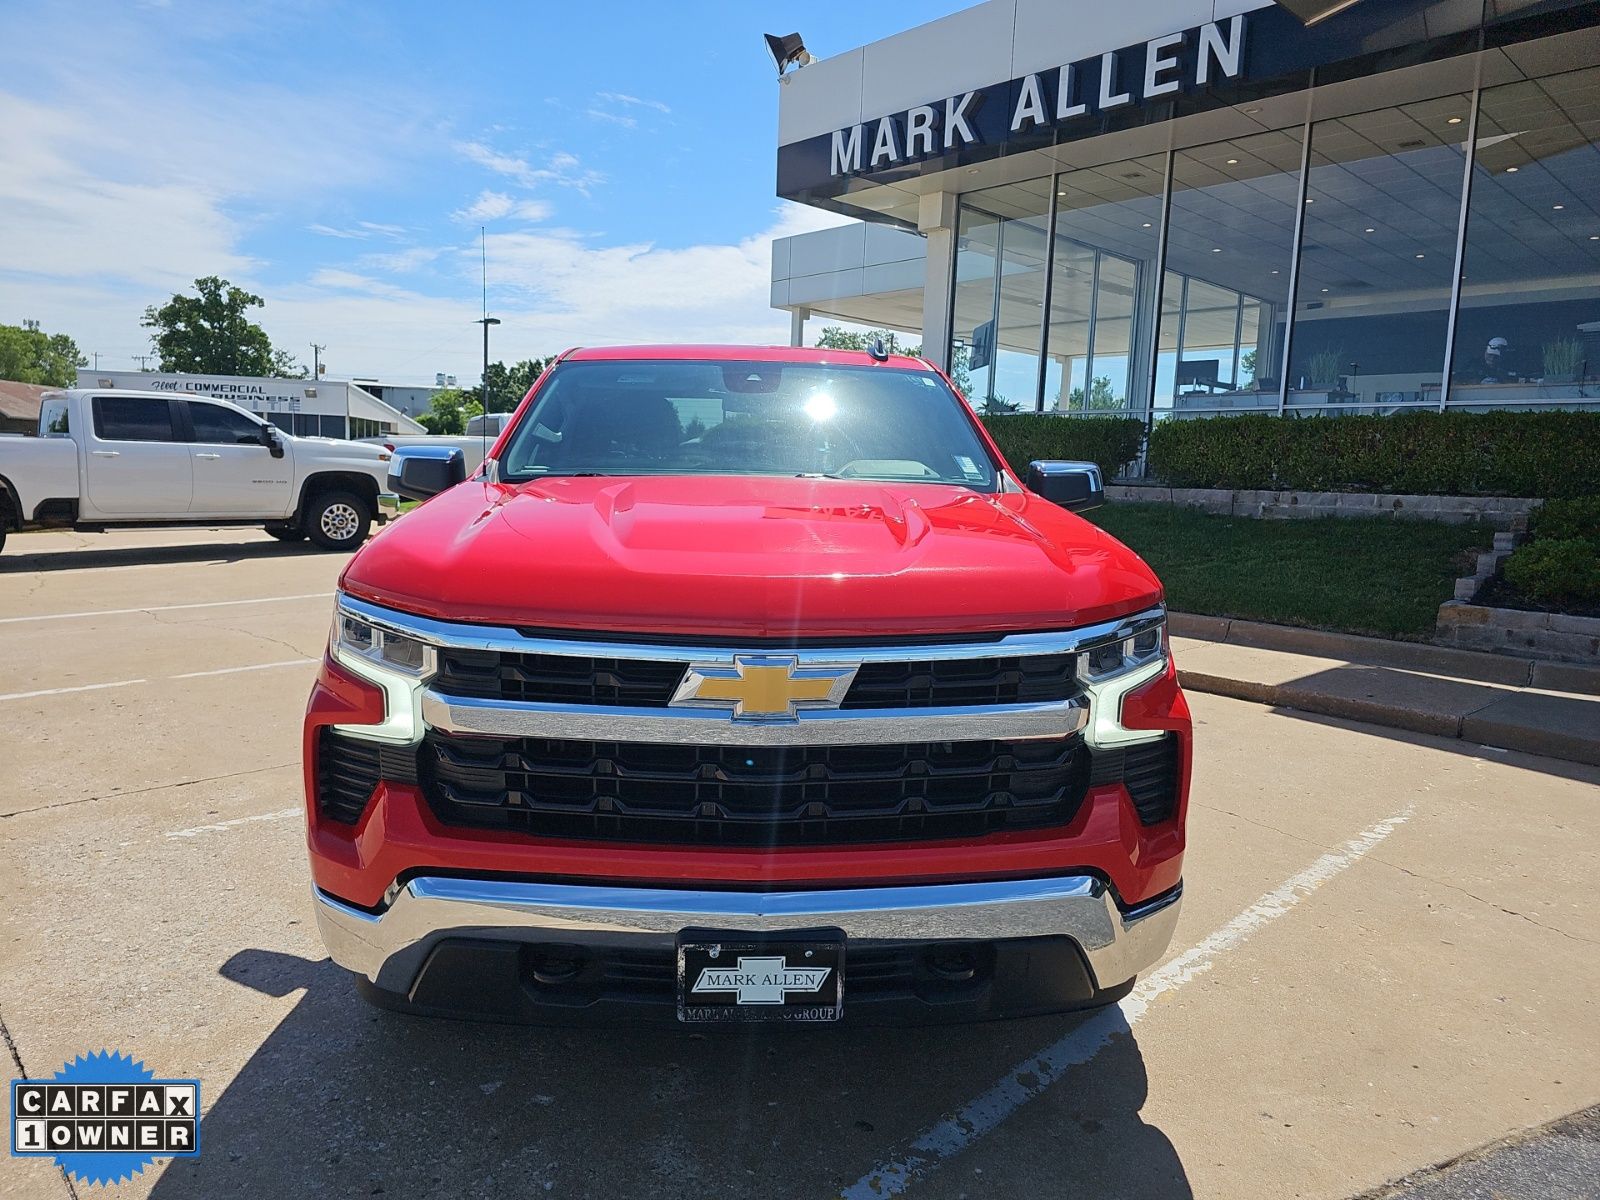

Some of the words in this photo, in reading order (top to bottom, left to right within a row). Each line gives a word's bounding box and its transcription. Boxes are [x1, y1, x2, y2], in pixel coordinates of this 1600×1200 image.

[830, 91, 979, 177] MARK
[1010, 14, 1248, 131] ALLEN
[151, 380, 179, 391] Fleet
[185, 382, 267, 394] COMMERCIAL
[211, 393, 301, 402] BUSINESS
[707, 974, 757, 986] MARK
[761, 974, 817, 986] ALLEN
[794, 1008, 834, 1020] GROUP
